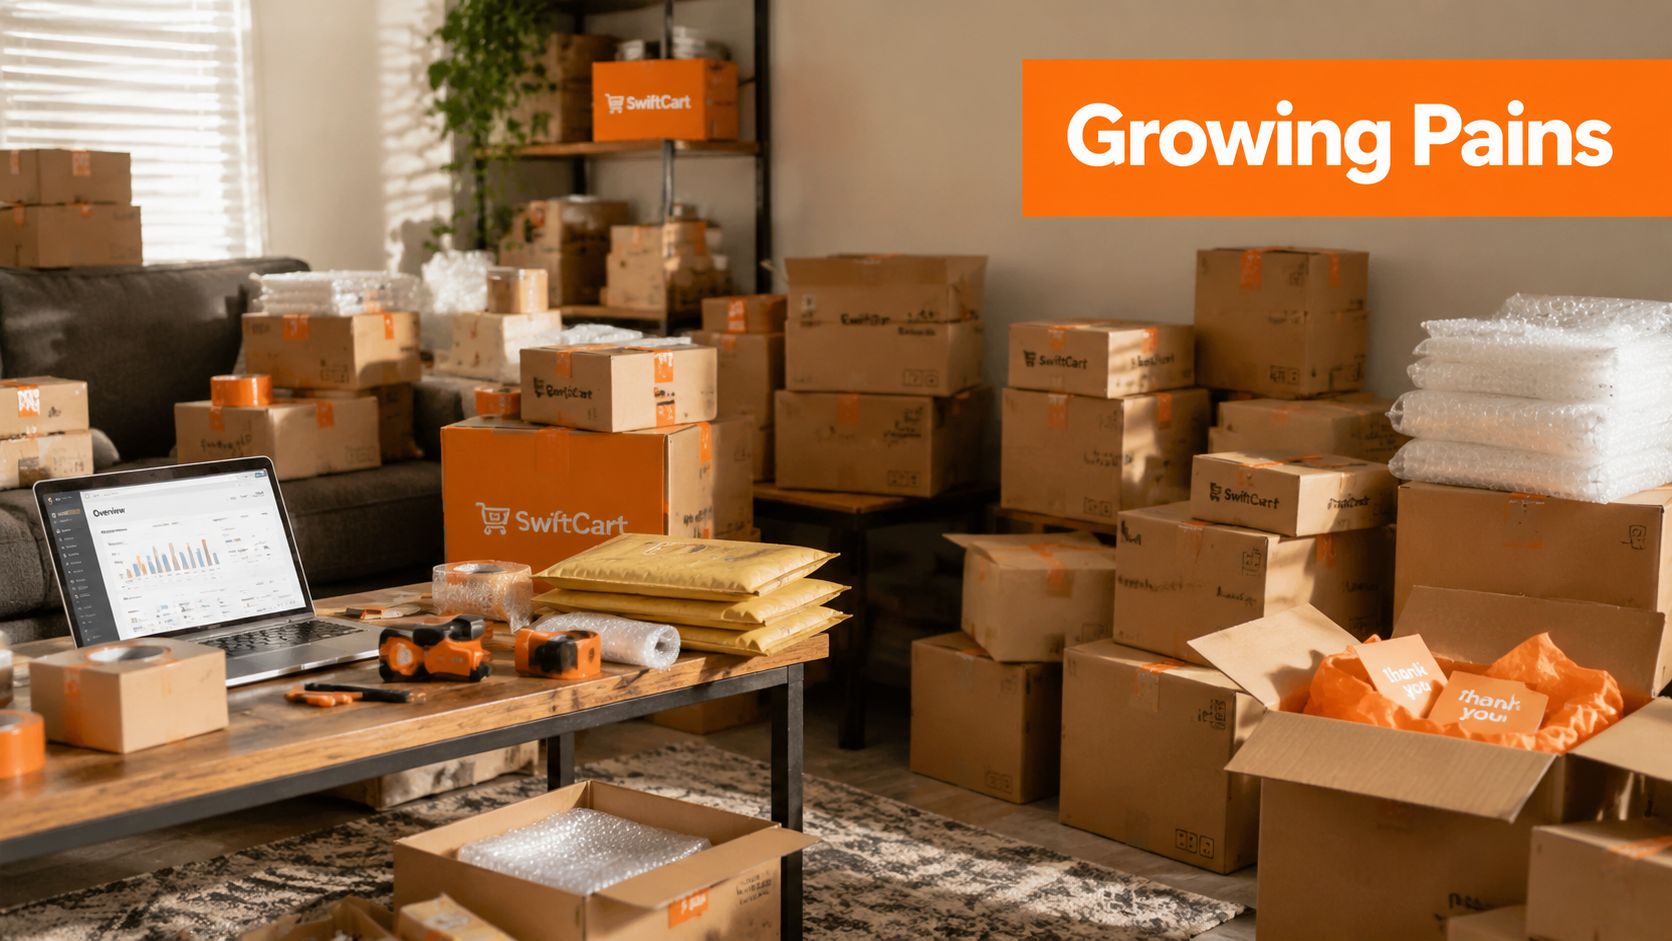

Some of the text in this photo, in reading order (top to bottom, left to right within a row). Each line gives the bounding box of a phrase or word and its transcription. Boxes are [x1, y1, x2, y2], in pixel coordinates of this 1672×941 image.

[626, 94, 692, 110] SwiftCart
[515, 510, 629, 536] SwiftCart
[1402, 681, 1432, 701] you
